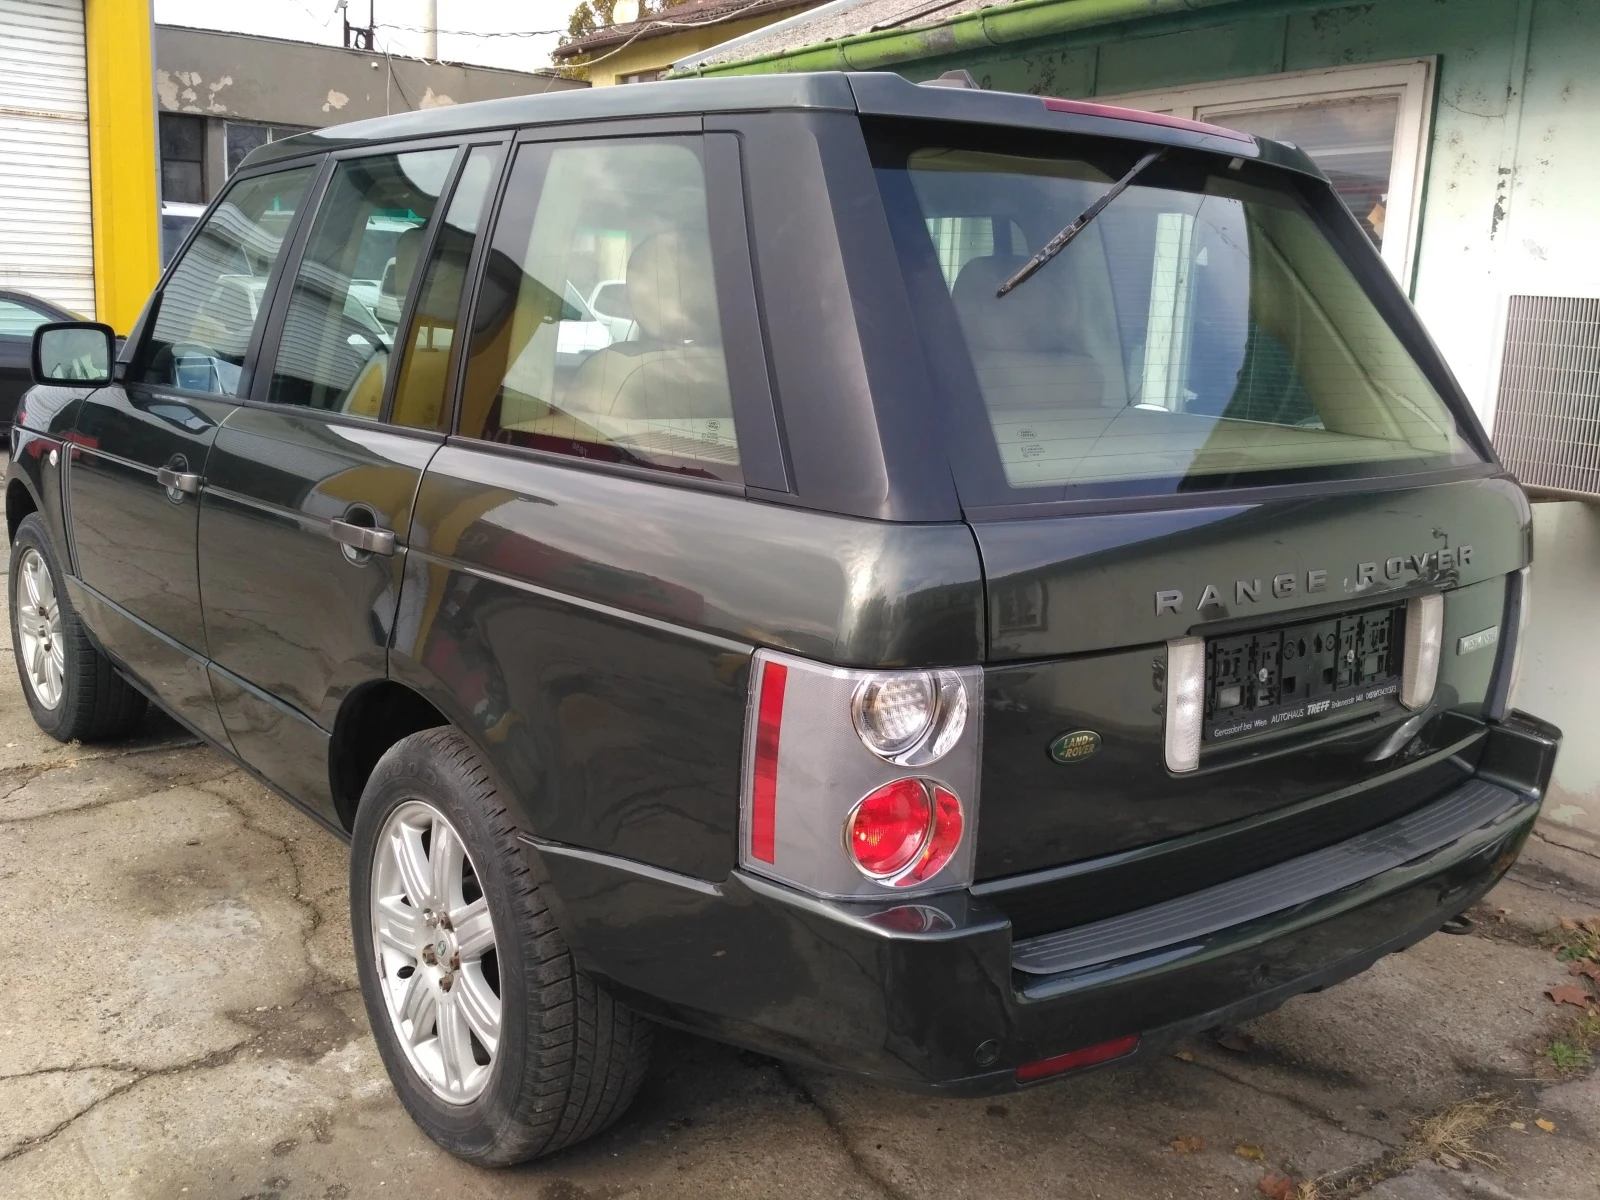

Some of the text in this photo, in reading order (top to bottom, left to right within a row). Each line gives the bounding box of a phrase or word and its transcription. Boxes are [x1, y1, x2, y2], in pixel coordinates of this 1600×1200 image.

[1156, 545, 1474, 616] RANGE ROVER
[1254, 719, 1267, 729] Wien
[1271, 708, 1304, 724] AUTOHAUS
[1307, 700, 1330, 715] TREFF
[1065, 744, 1095, 758] ROVER
